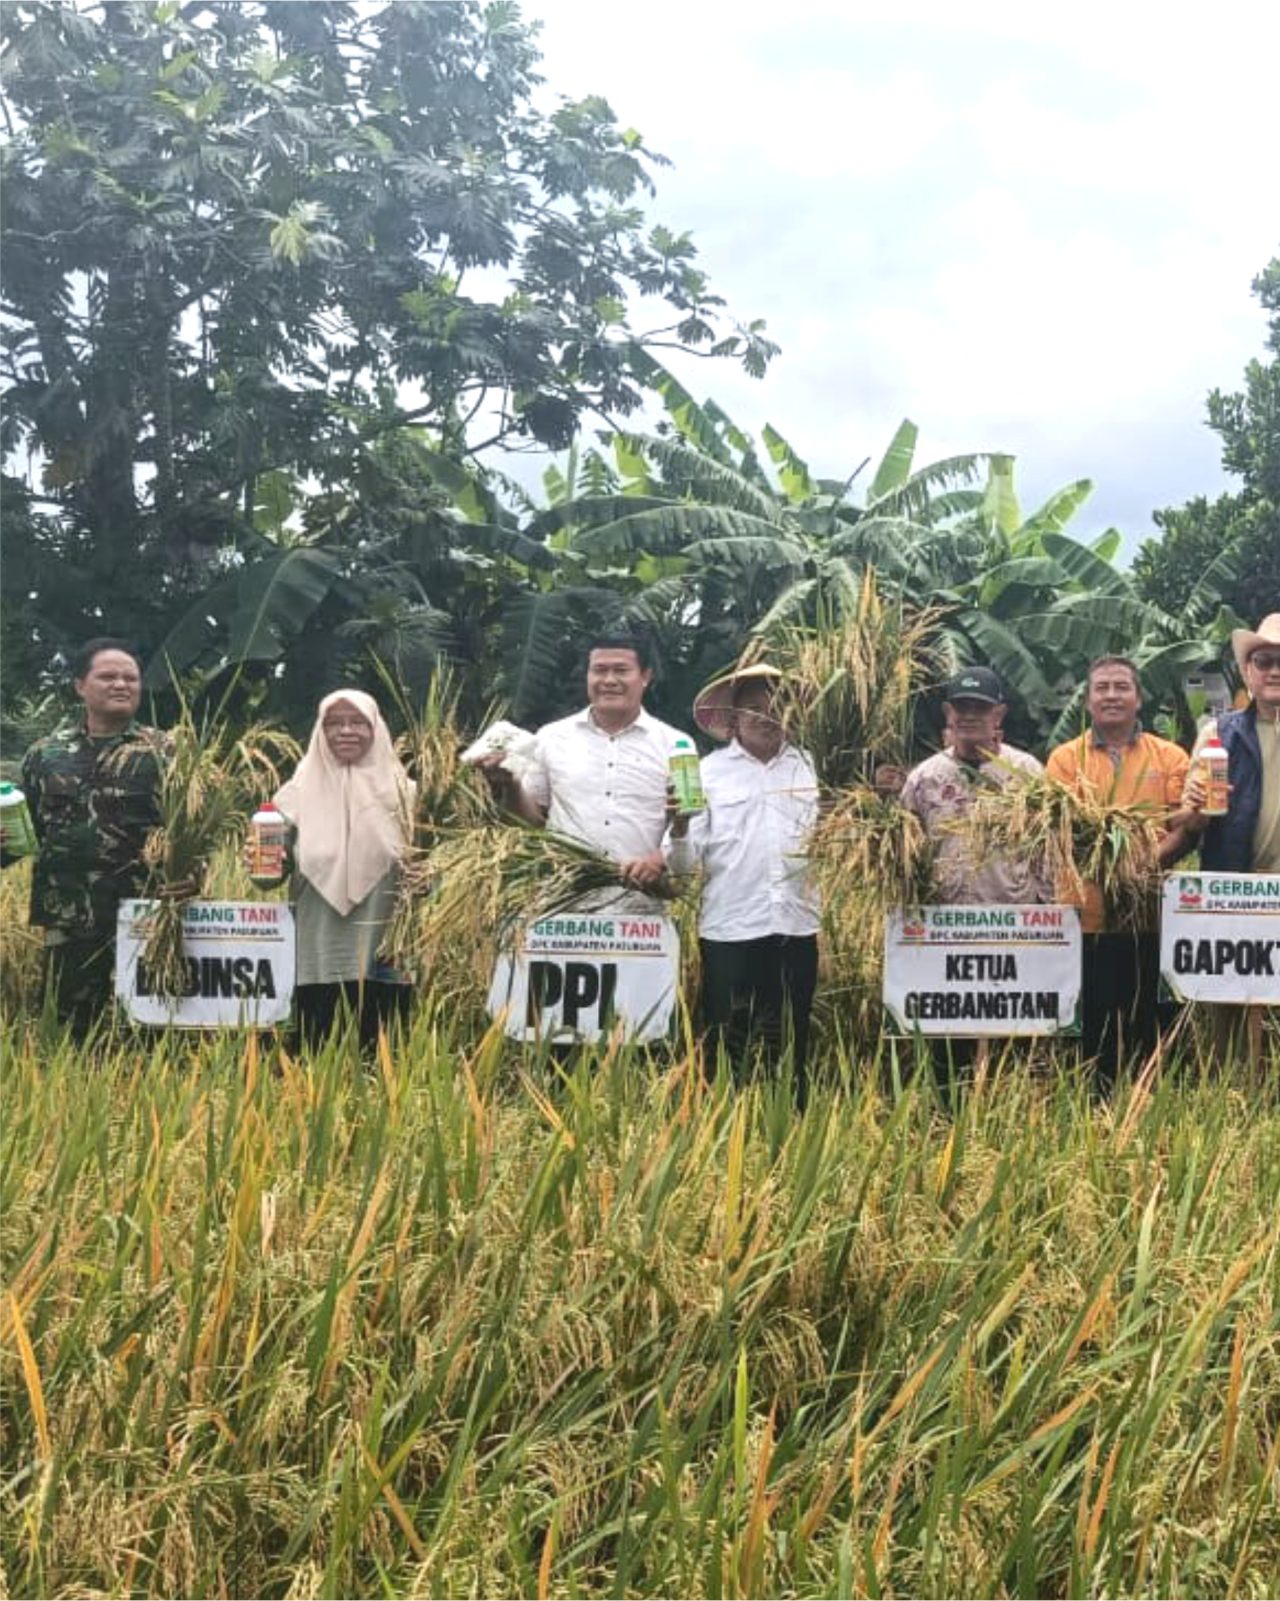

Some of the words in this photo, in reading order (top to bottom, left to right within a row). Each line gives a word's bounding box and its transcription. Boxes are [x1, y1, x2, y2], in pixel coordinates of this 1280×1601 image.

[184, 907, 234, 922] BANG
[238, 907, 277, 922] TANI
[933, 911, 1015, 927] GERBANG
[1021, 911, 1062, 927] TANI
[534, 920, 615, 937] GERBANG
[620, 921, 661, 938] TANI
[136, 956, 276, 999] BBINSA
[945, 954, 1018, 982] KETUA
[526, 961, 617, 1031] PPI
[904, 991, 1060, 1020] GERBANGTANI
